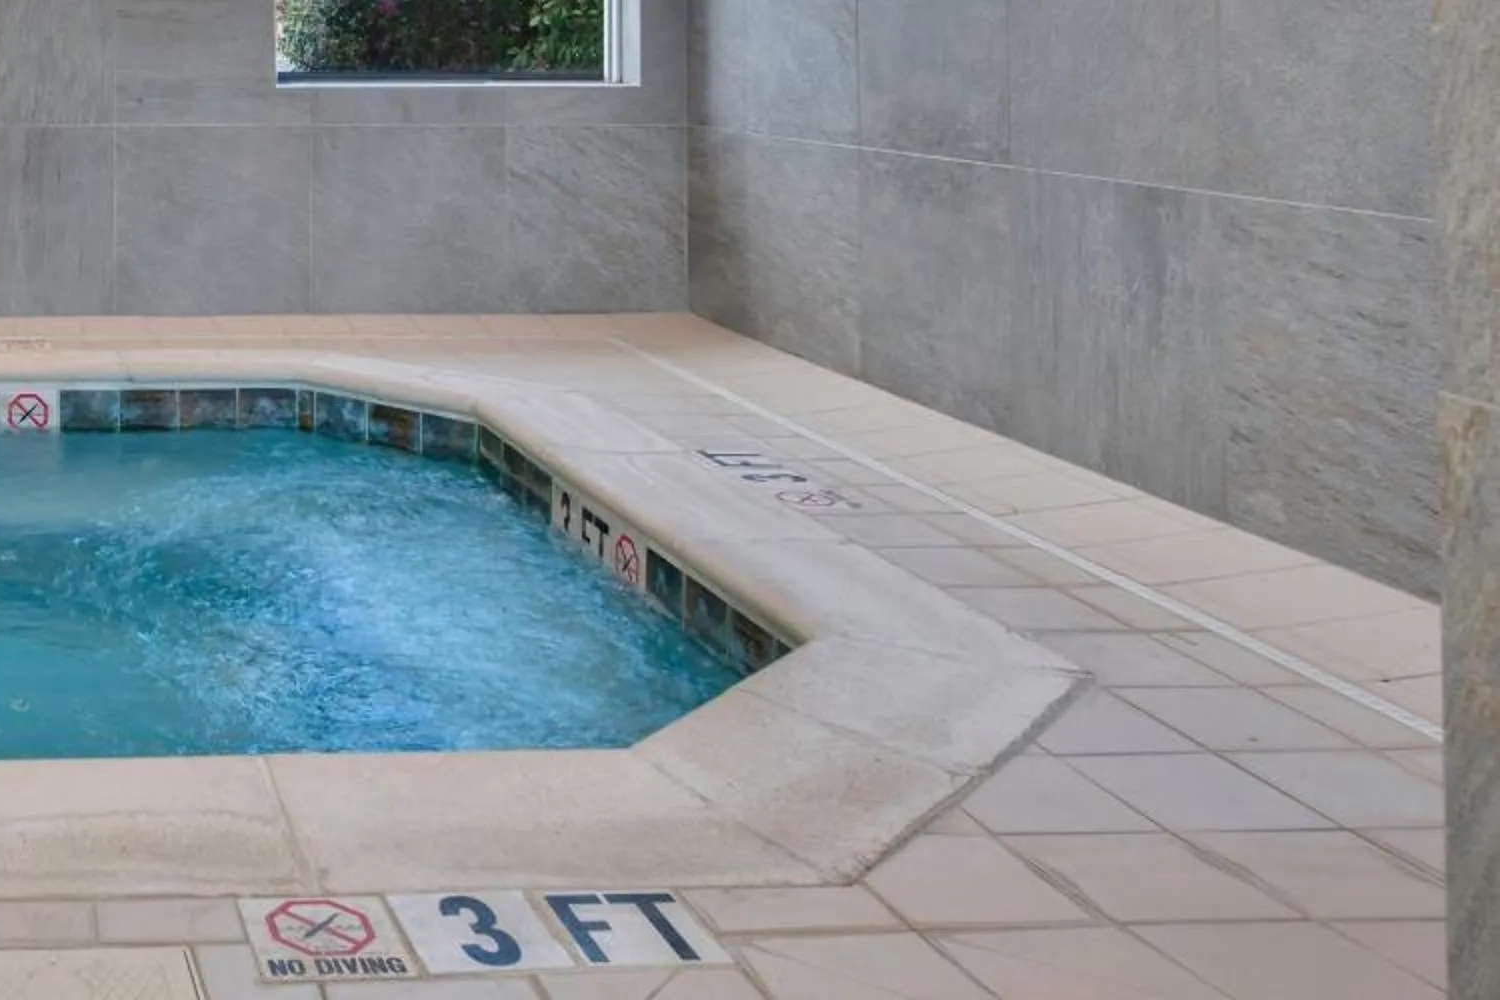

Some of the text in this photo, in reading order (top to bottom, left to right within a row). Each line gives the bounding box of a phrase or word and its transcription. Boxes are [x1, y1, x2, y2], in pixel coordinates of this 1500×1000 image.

[581, 506, 610, 559] FT
[439, 893, 701, 966] 3 FT
[267, 955, 407, 976] NO DIVING
